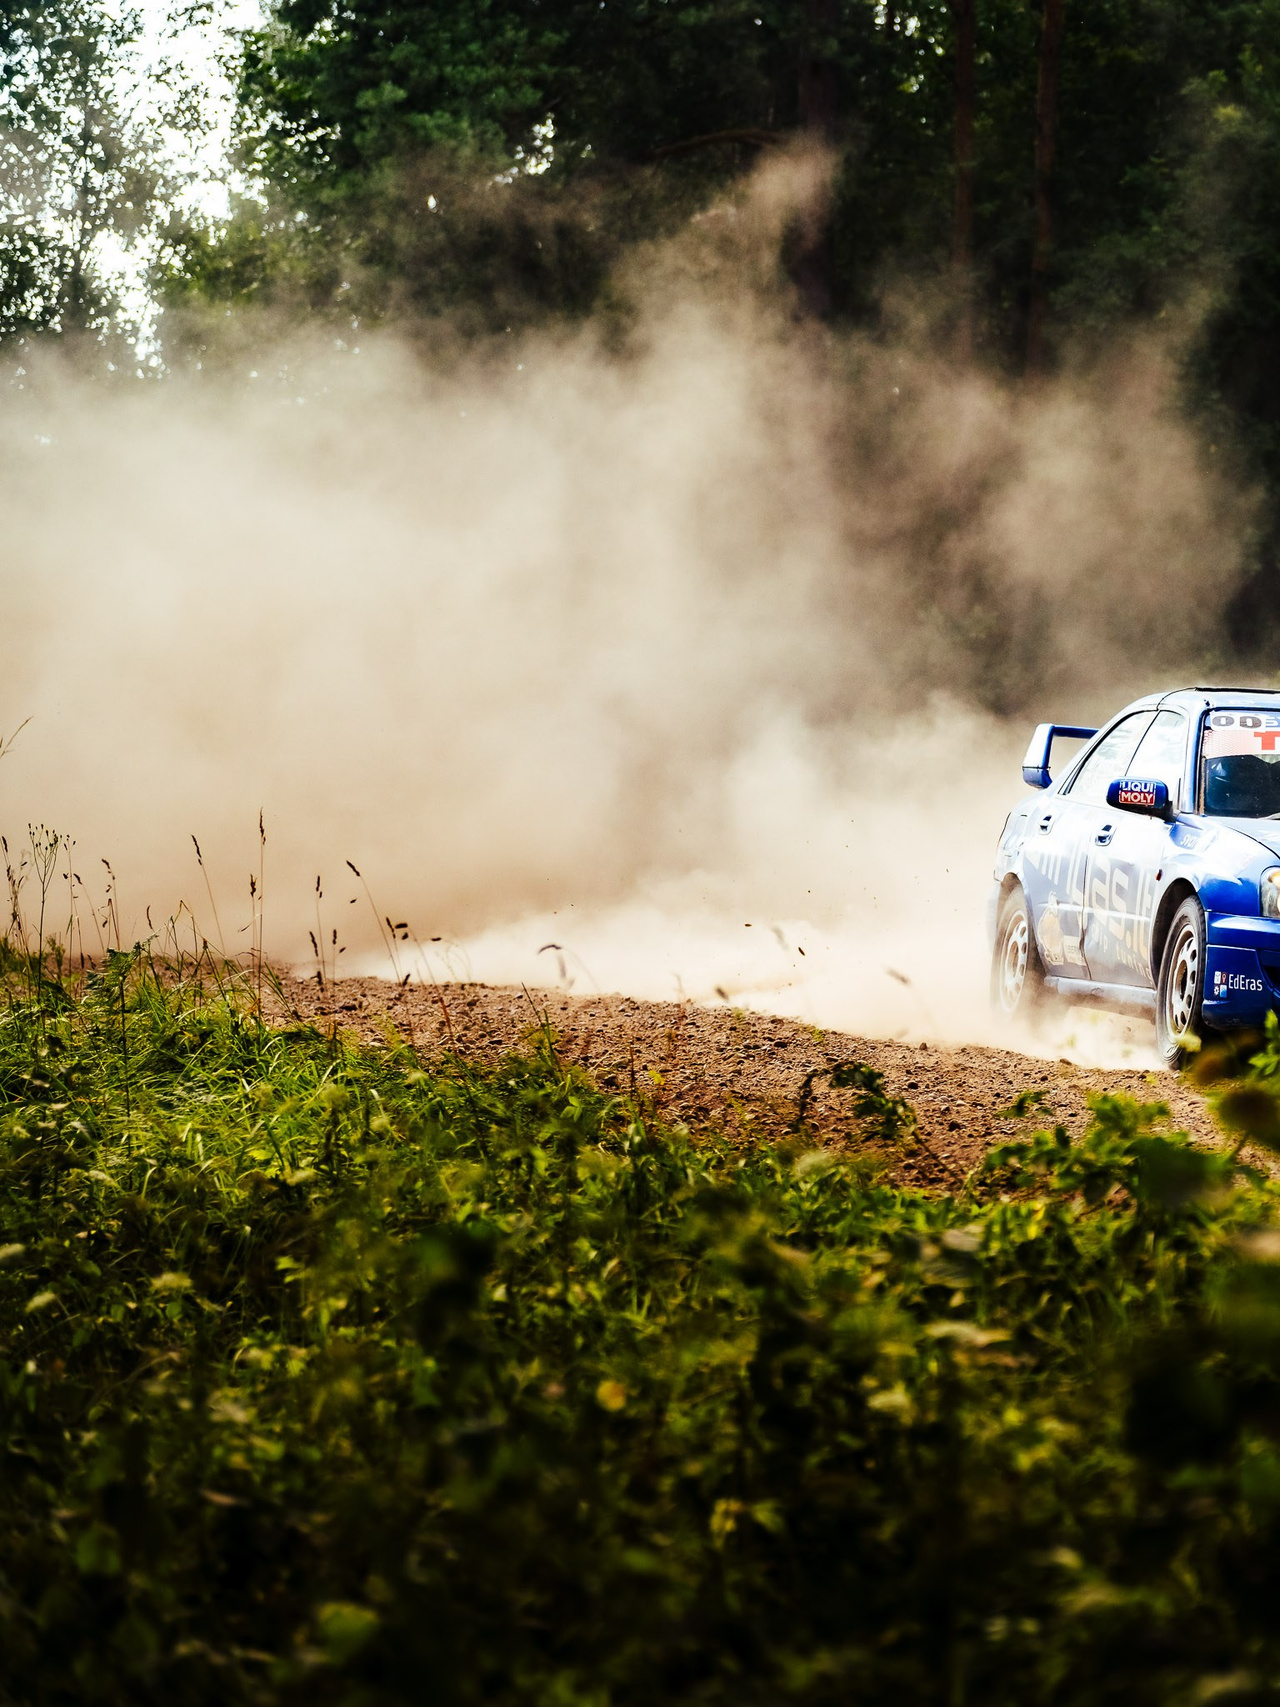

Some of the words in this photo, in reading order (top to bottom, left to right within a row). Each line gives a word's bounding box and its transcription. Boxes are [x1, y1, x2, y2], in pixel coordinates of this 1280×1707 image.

[1122, 781, 1154, 793] LIQUI
[1121, 792, 1153, 804] MOLY
[1228, 973, 1263, 991] EdEras
